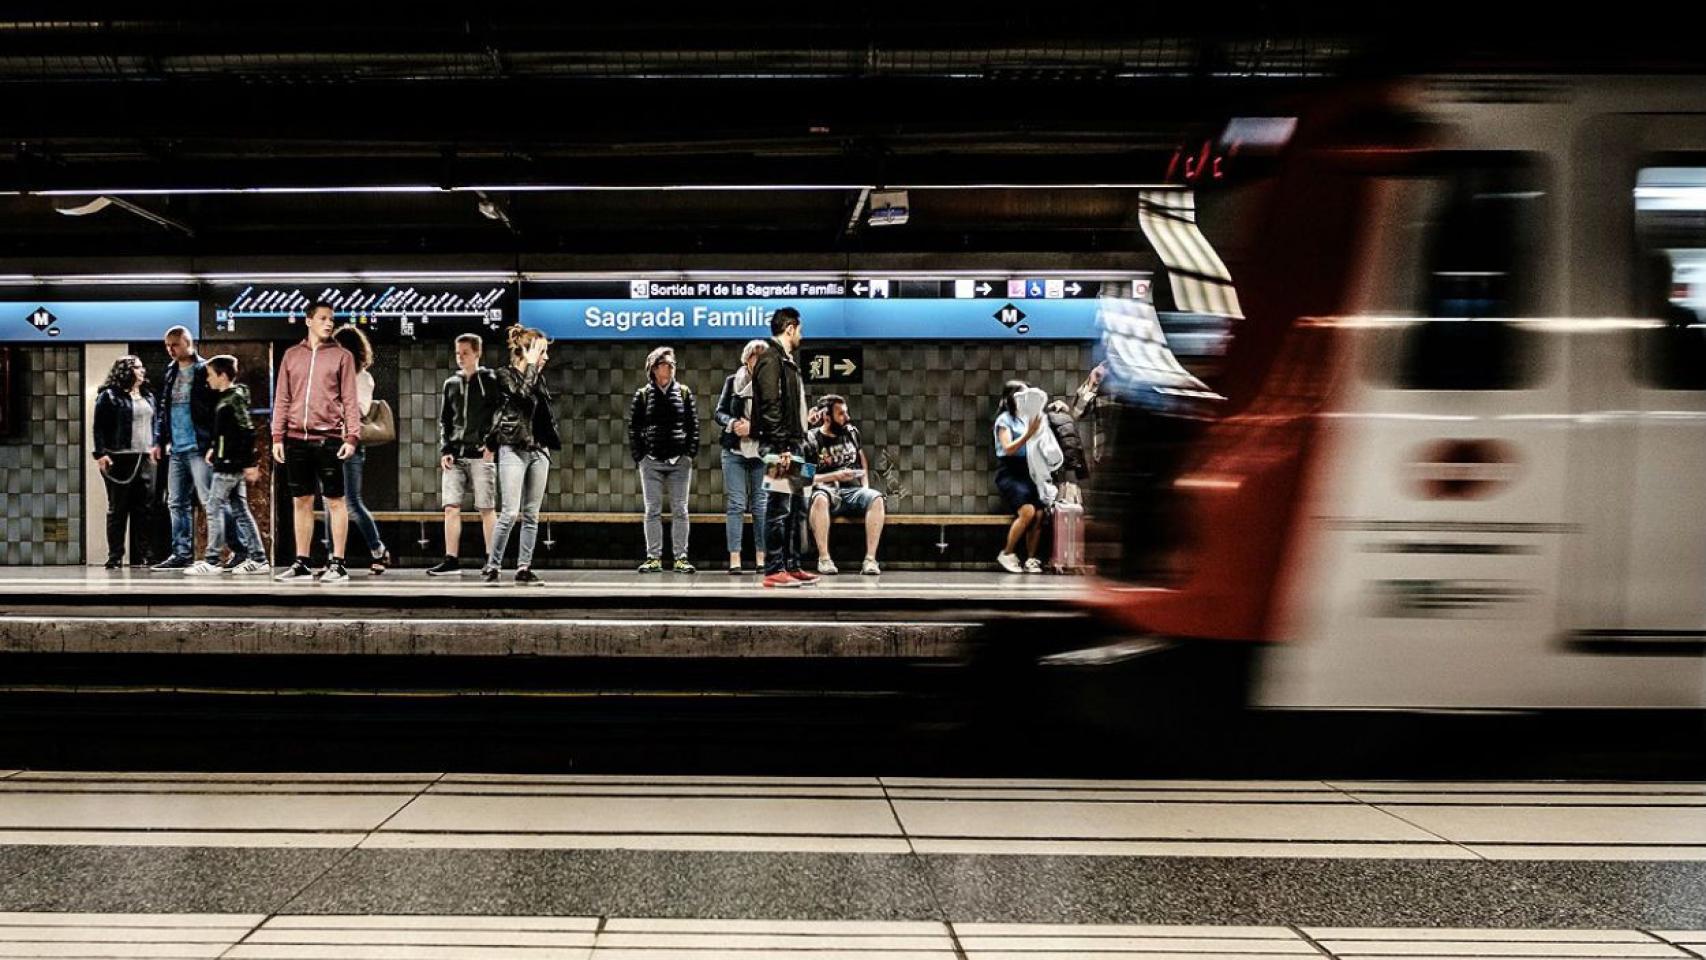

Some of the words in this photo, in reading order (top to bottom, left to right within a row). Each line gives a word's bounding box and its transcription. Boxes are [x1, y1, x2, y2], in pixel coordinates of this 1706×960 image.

[650, 283, 694, 296] Sortida
[713, 283, 730, 296] de
[731, 283, 744, 296] la
[746, 283, 798, 298] Sagrada
[33, 312, 49, 326] M
[584, 306, 685, 332] Sagrada
[1001, 309, 1018, 323] M
